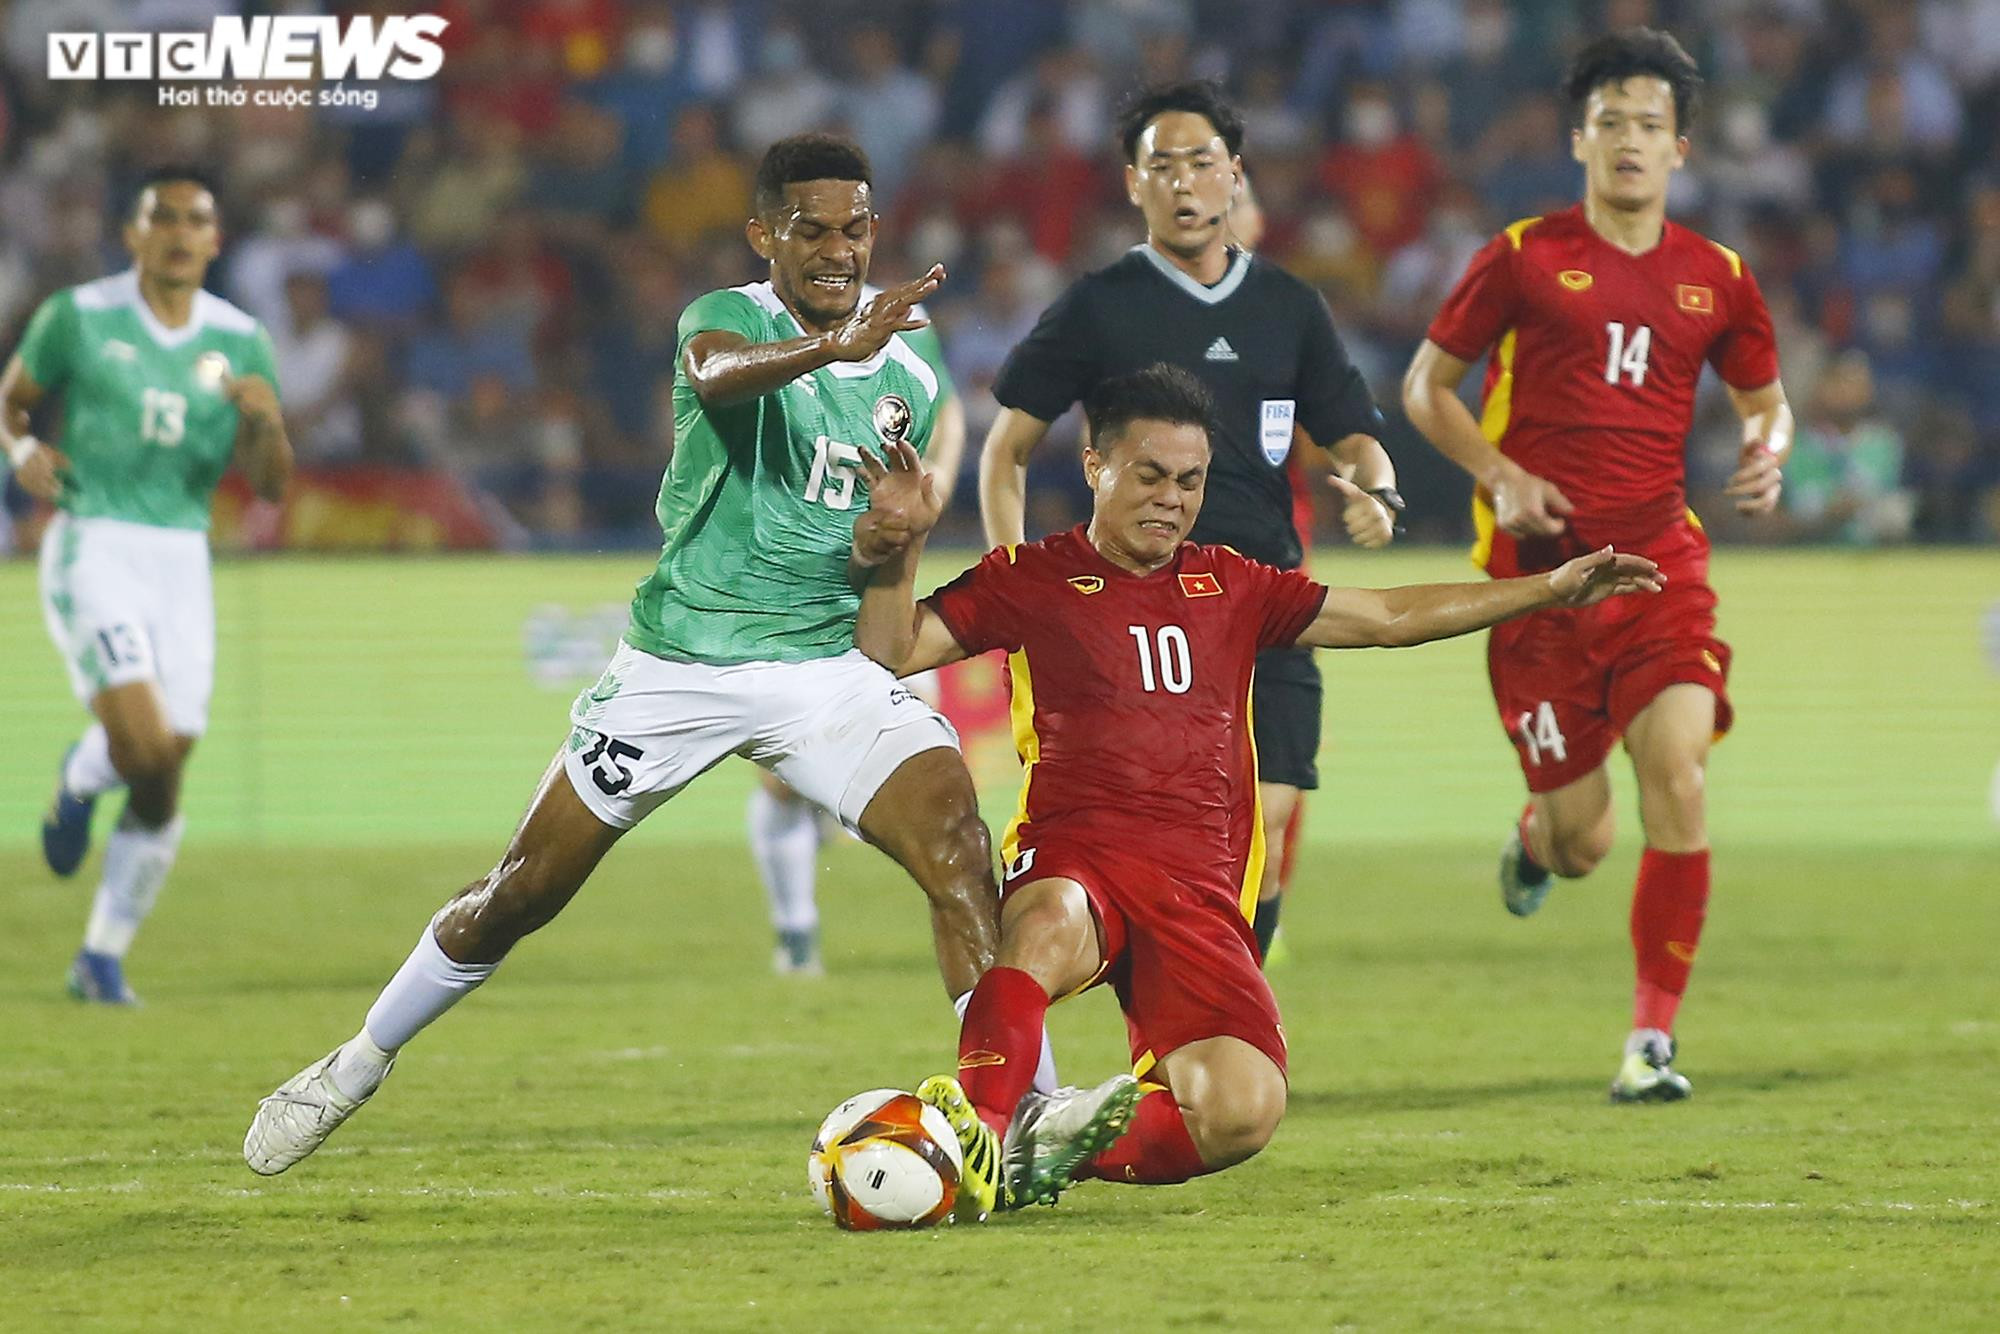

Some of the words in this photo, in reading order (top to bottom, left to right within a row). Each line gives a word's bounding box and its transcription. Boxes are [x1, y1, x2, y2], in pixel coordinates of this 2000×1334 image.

[1605, 321, 1651, 387] 14
[143, 387, 188, 448] 13
[1266, 404, 1291, 419] FIFA
[803, 435, 863, 510] 15
[1128, 625, 1193, 694] 10
[1519, 701, 1567, 767] 14
